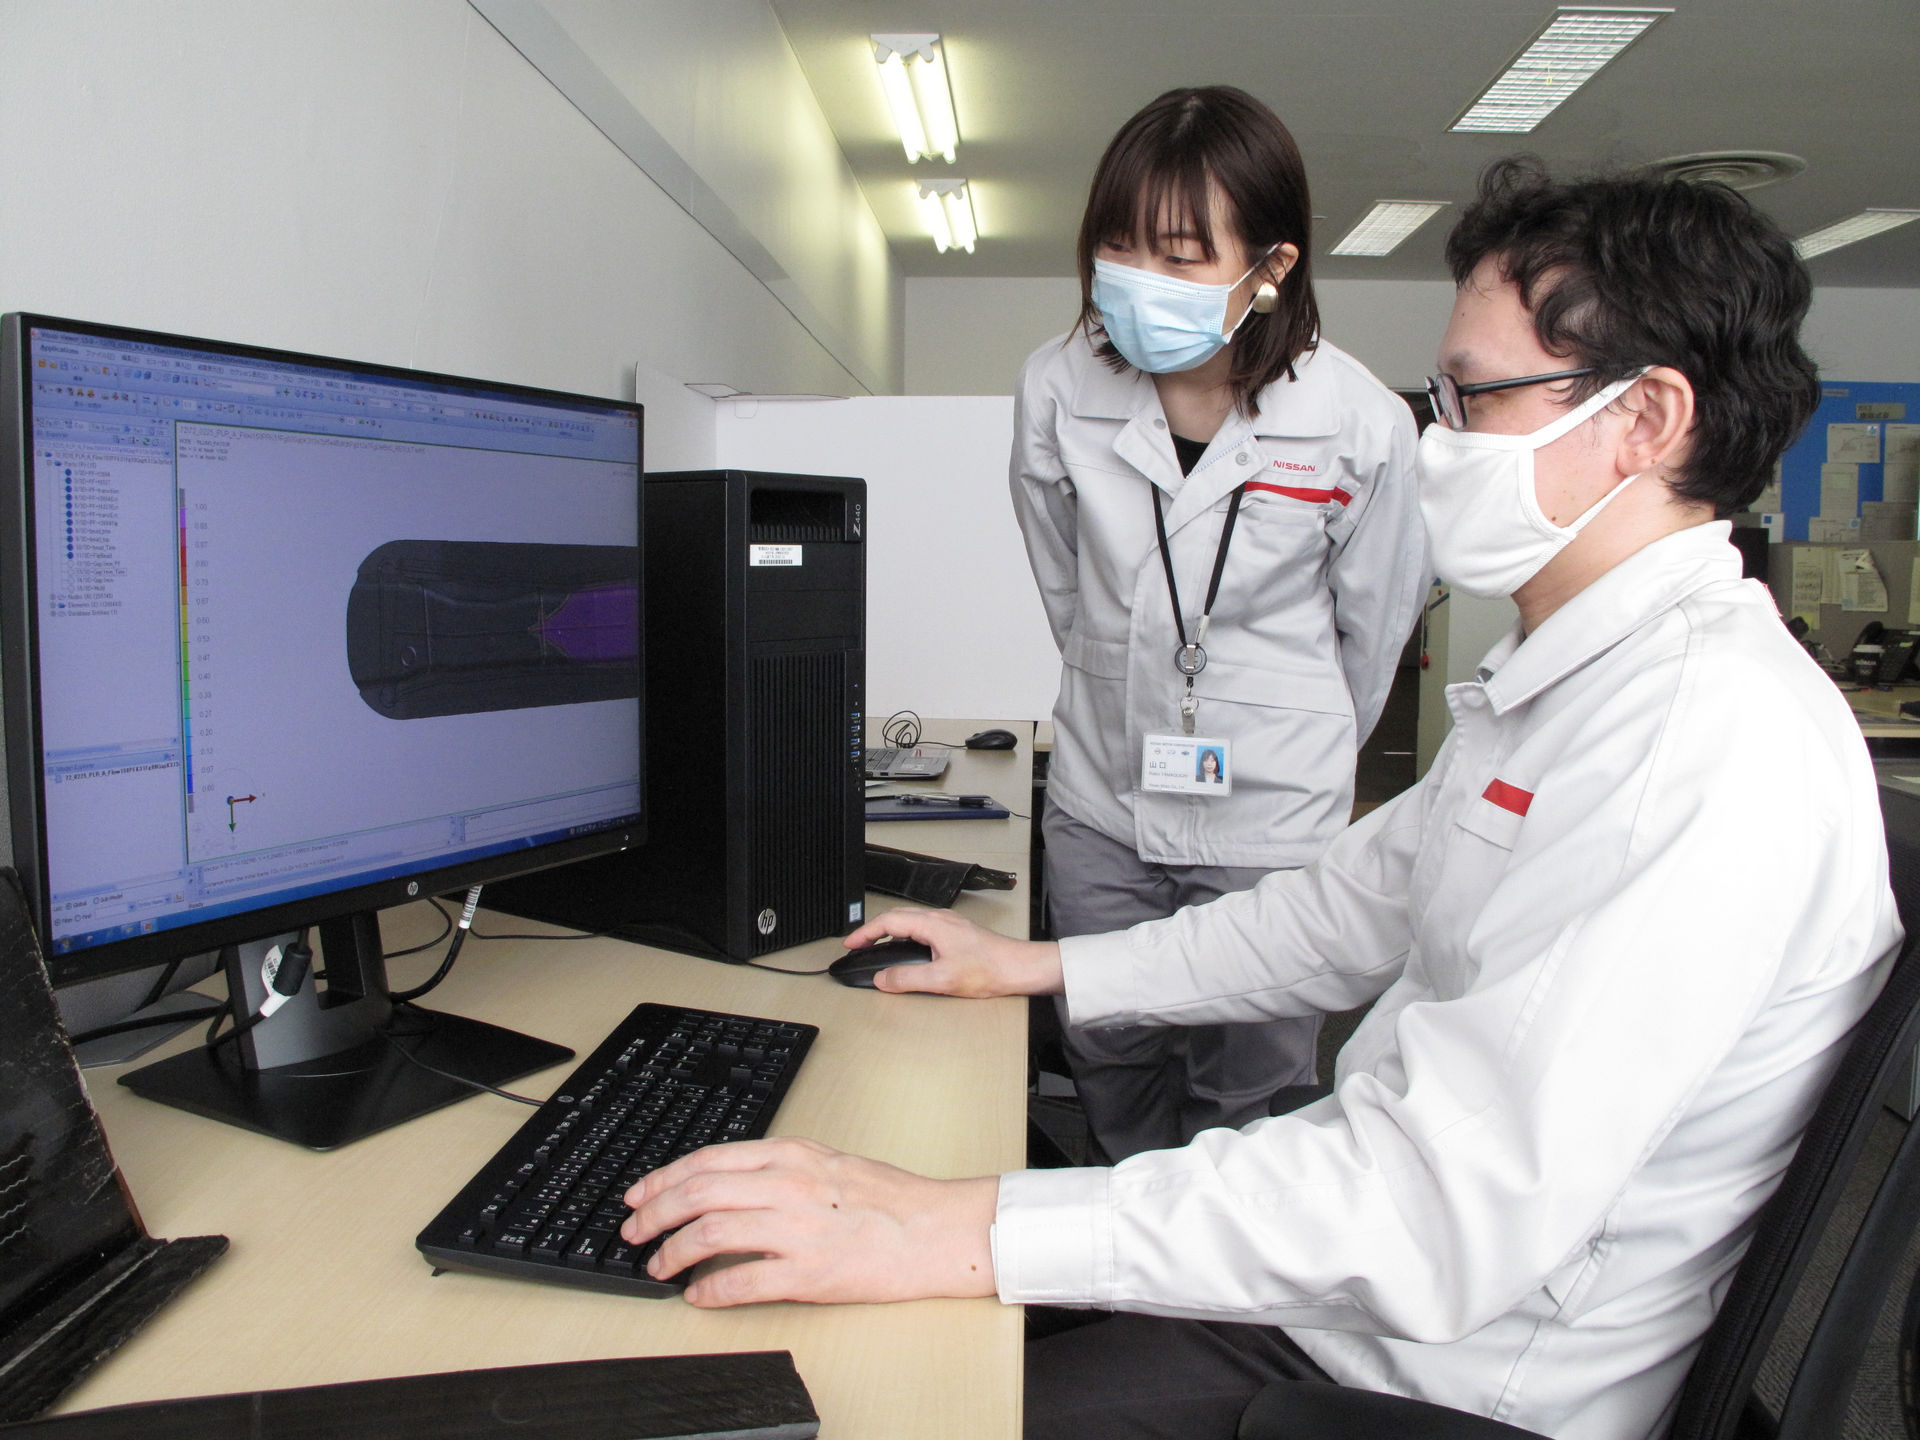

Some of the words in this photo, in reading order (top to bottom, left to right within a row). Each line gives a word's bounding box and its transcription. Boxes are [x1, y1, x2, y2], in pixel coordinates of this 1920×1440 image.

[1273, 460, 1316, 472] NISSAN
[853, 504, 861, 537] Z440
[758, 908, 777, 935] hp
